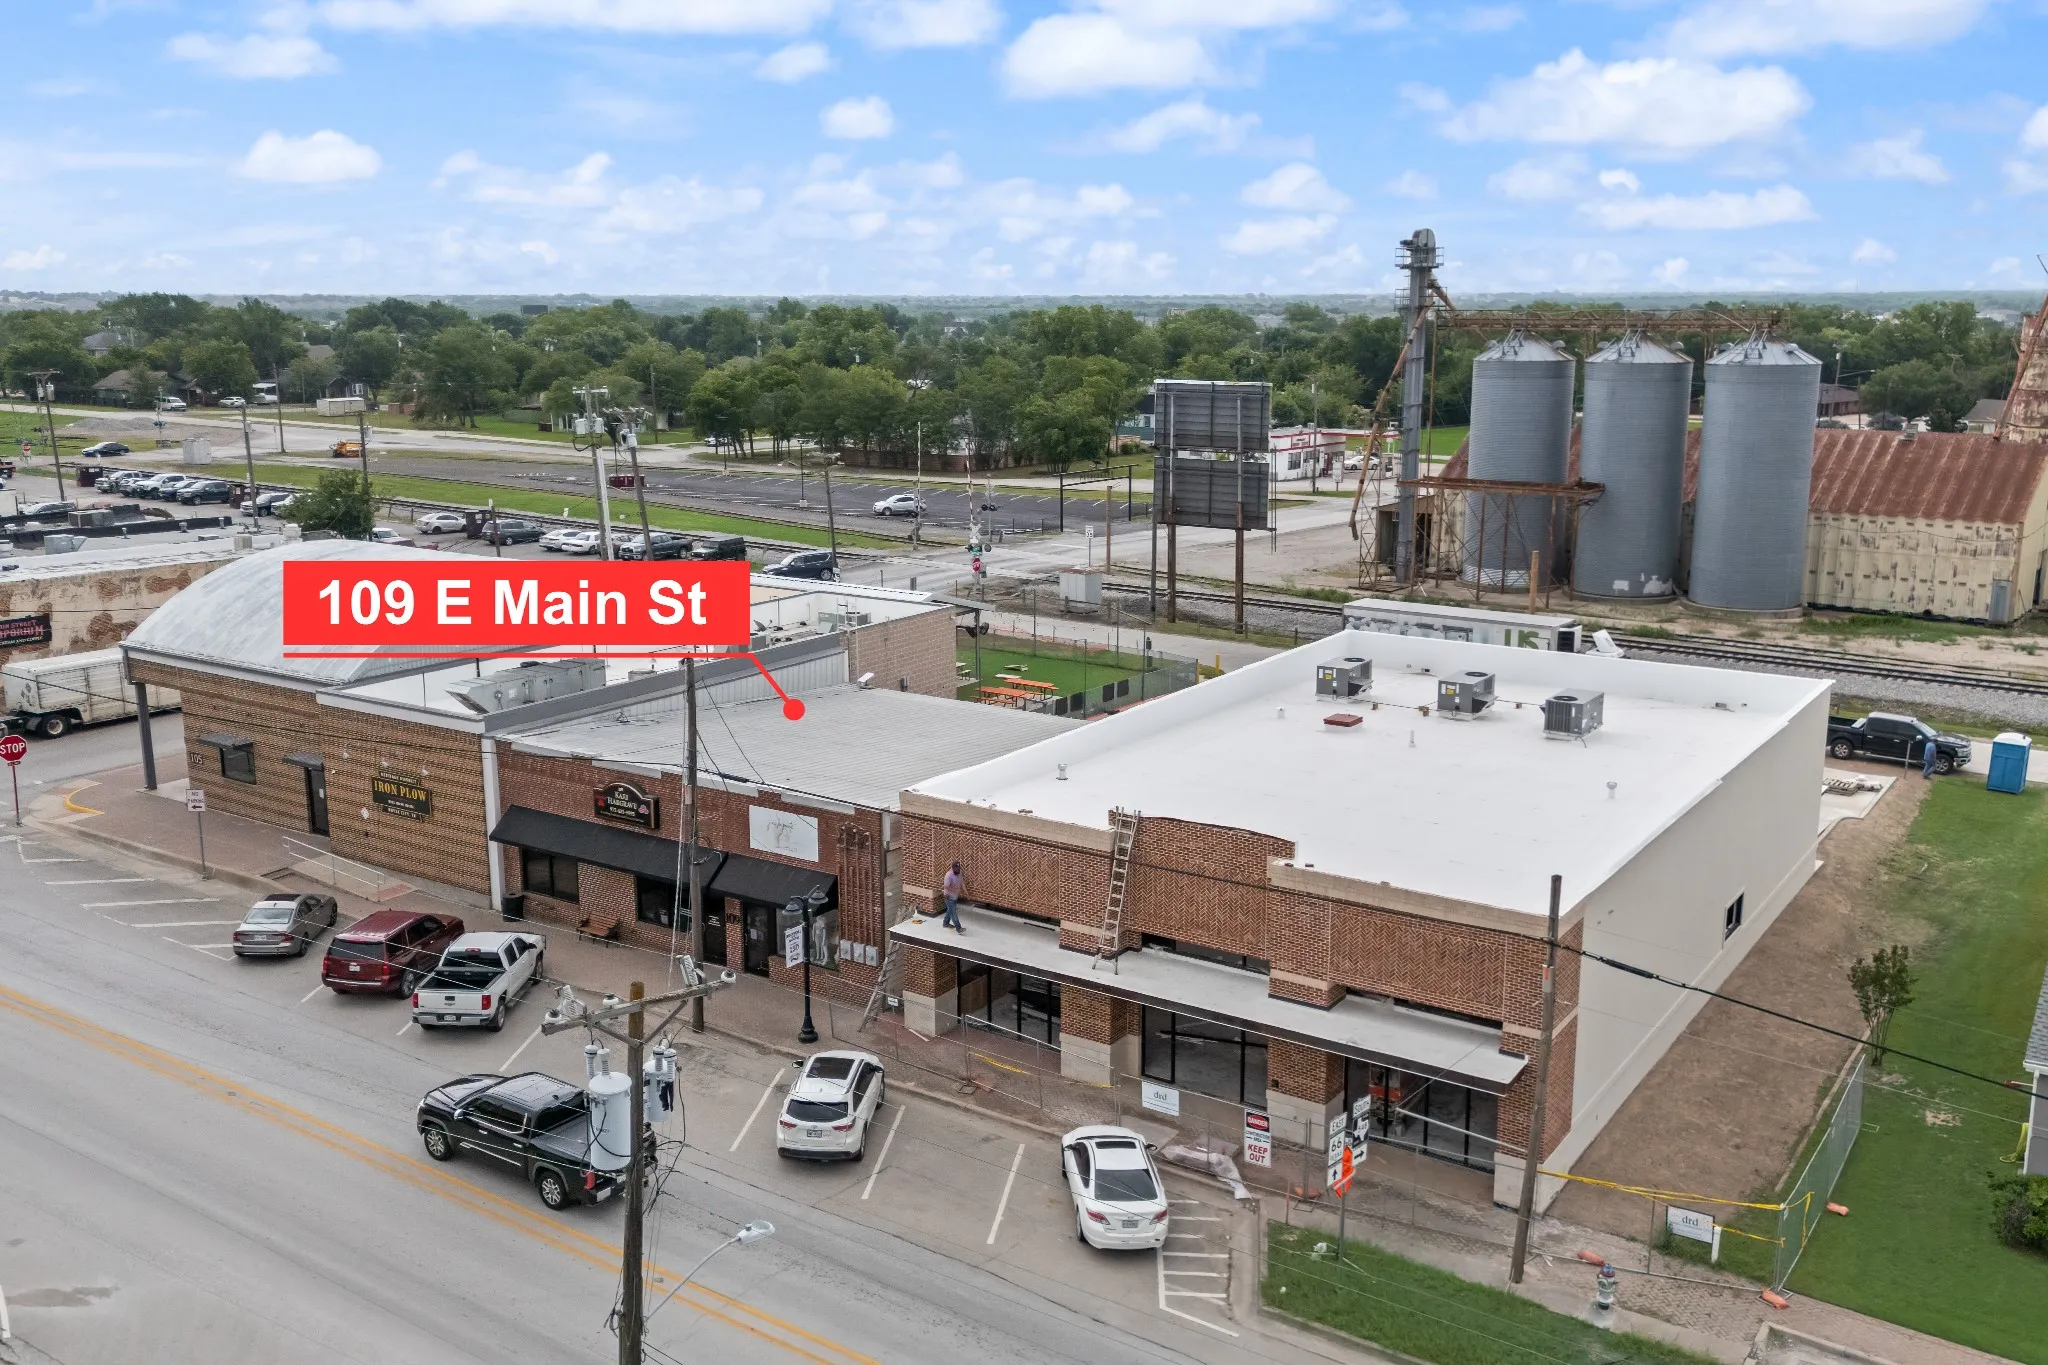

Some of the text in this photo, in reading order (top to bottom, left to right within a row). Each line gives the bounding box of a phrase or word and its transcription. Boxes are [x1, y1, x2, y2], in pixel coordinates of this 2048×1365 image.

[11, 619, 36, 628] STREET
[0, 742, 25, 755] STOP
[190, 753, 203, 764] 105
[374, 779, 427, 801] IRON PLOW
[1354, 1101, 1370, 1115] SOUTH
[1247, 1116, 1269, 1127] DANGER
[1332, 1118, 1345, 1131] EAST
[1247, 1143, 1268, 1155] KEEP
[1331, 1138, 1342, 1152] 66
[1249, 1152, 1266, 1163] OUT
[1681, 1215, 1699, 1226] drd
